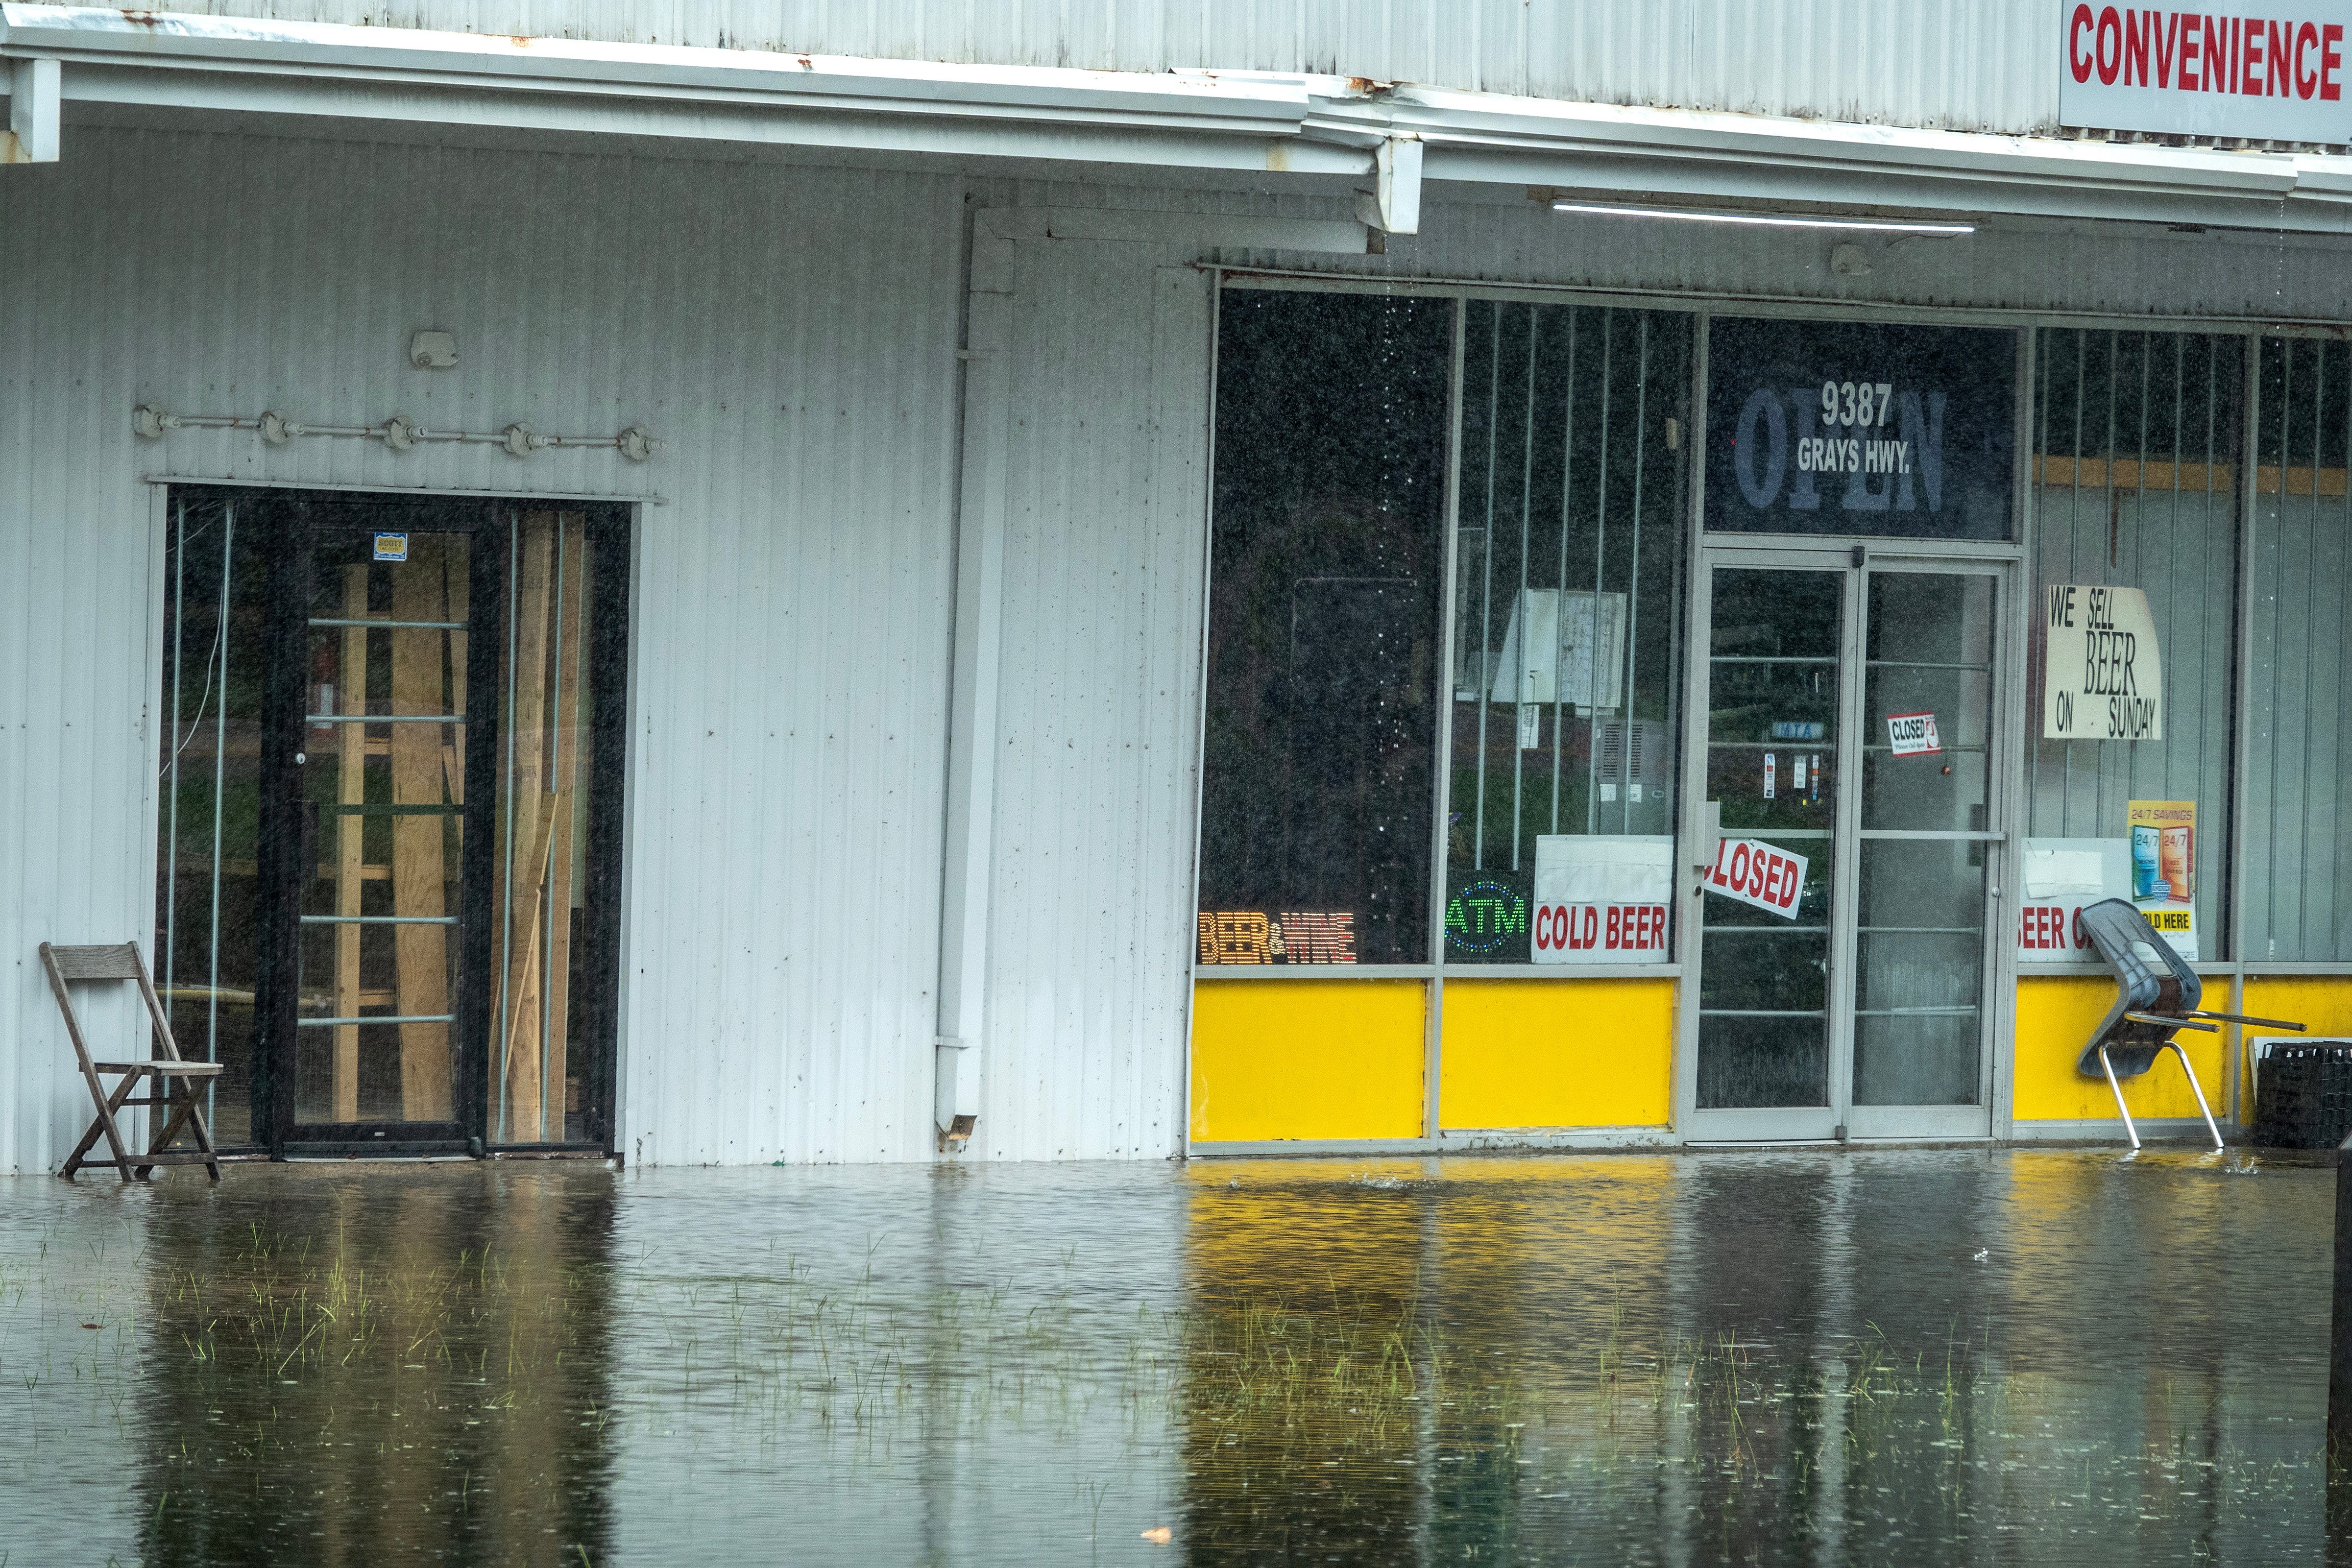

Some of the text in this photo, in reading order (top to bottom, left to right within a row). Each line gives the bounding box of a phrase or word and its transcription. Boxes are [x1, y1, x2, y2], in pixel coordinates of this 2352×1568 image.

[2070, 3, 2343, 101] CONVENIENCE
[1821, 381, 1892, 427] 9387
[1797, 437, 1910, 474] GRAYS HWY.
[2051, 585, 2114, 630] WE SELL
[2084, 630, 2137, 697] BEER
[1892, 719, 1925, 741] CLOSED
[2057, 690, 2156, 739] ON SUNDAY
[2153, 810, 2193, 820] SAVINGS
[2136, 834, 2159, 847] 24/7
[2163, 834, 2187, 847] 24/7
[1704, 837, 1799, 909] LOSED
[1445, 899, 1525, 934] ATM
[1536, 905, 1665, 950] COLD BEER
[2017, 907, 2066, 949] EER
[2164, 913, 2189, 929] HERE
[1198, 912, 1358, 965] BEER & WINE
